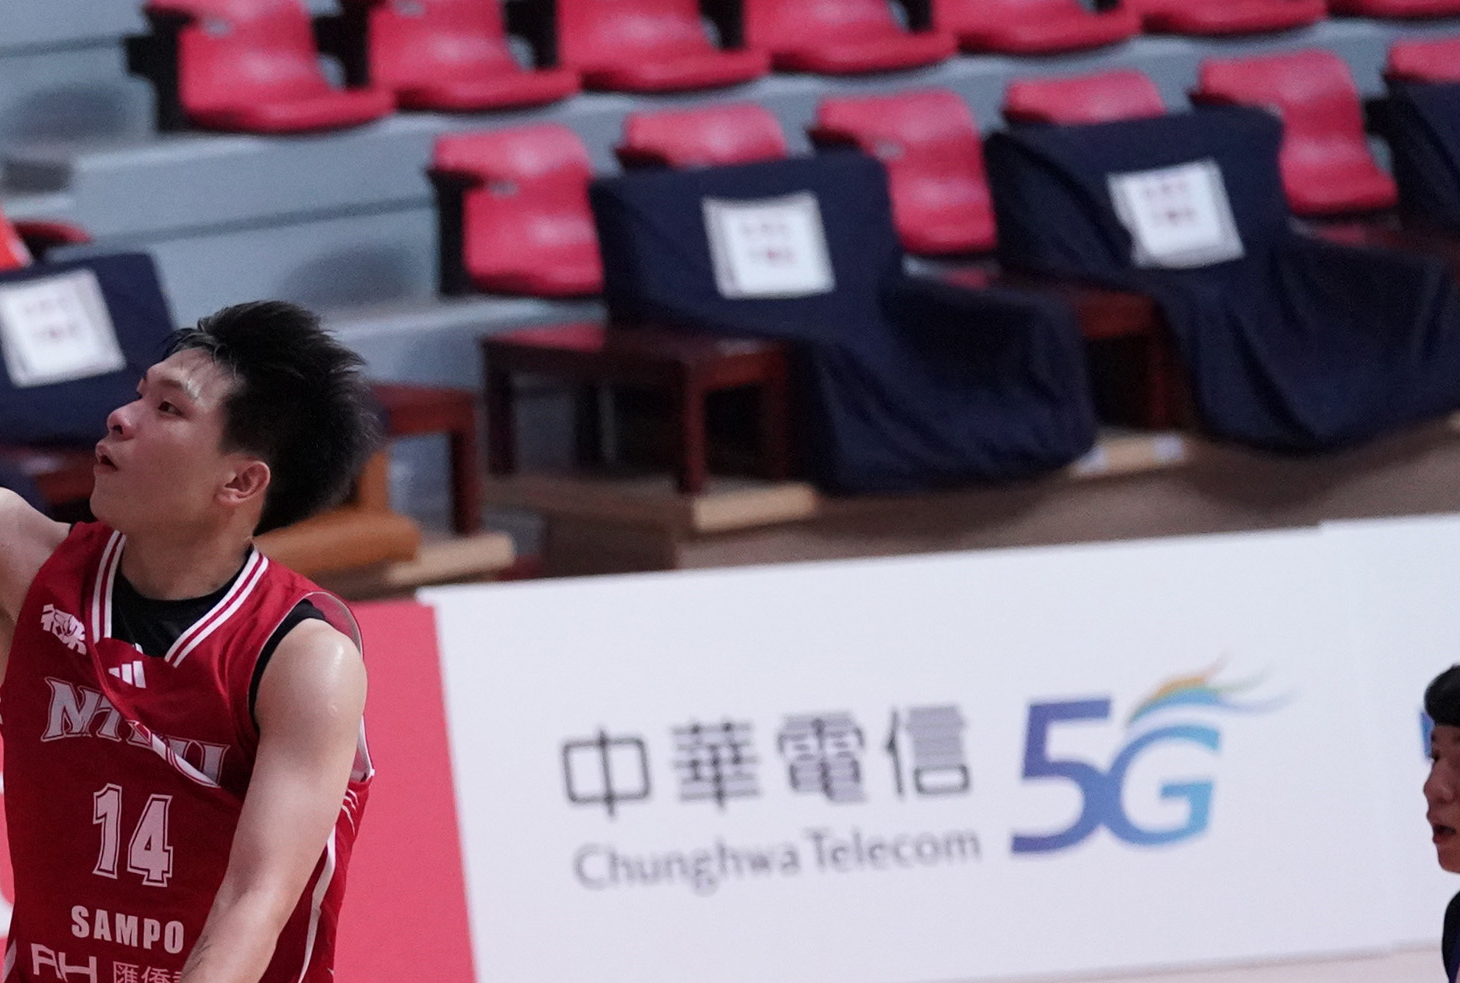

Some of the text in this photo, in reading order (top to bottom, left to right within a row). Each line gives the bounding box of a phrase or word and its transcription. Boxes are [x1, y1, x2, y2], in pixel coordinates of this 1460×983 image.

[560, 703, 972, 820] 中華電信
[1010, 695, 1222, 857] 5G
[92, 783, 173, 888] 14
[572, 826, 982, 896] Chunghwa Telecom
[71, 905, 185, 954] SAMPO
